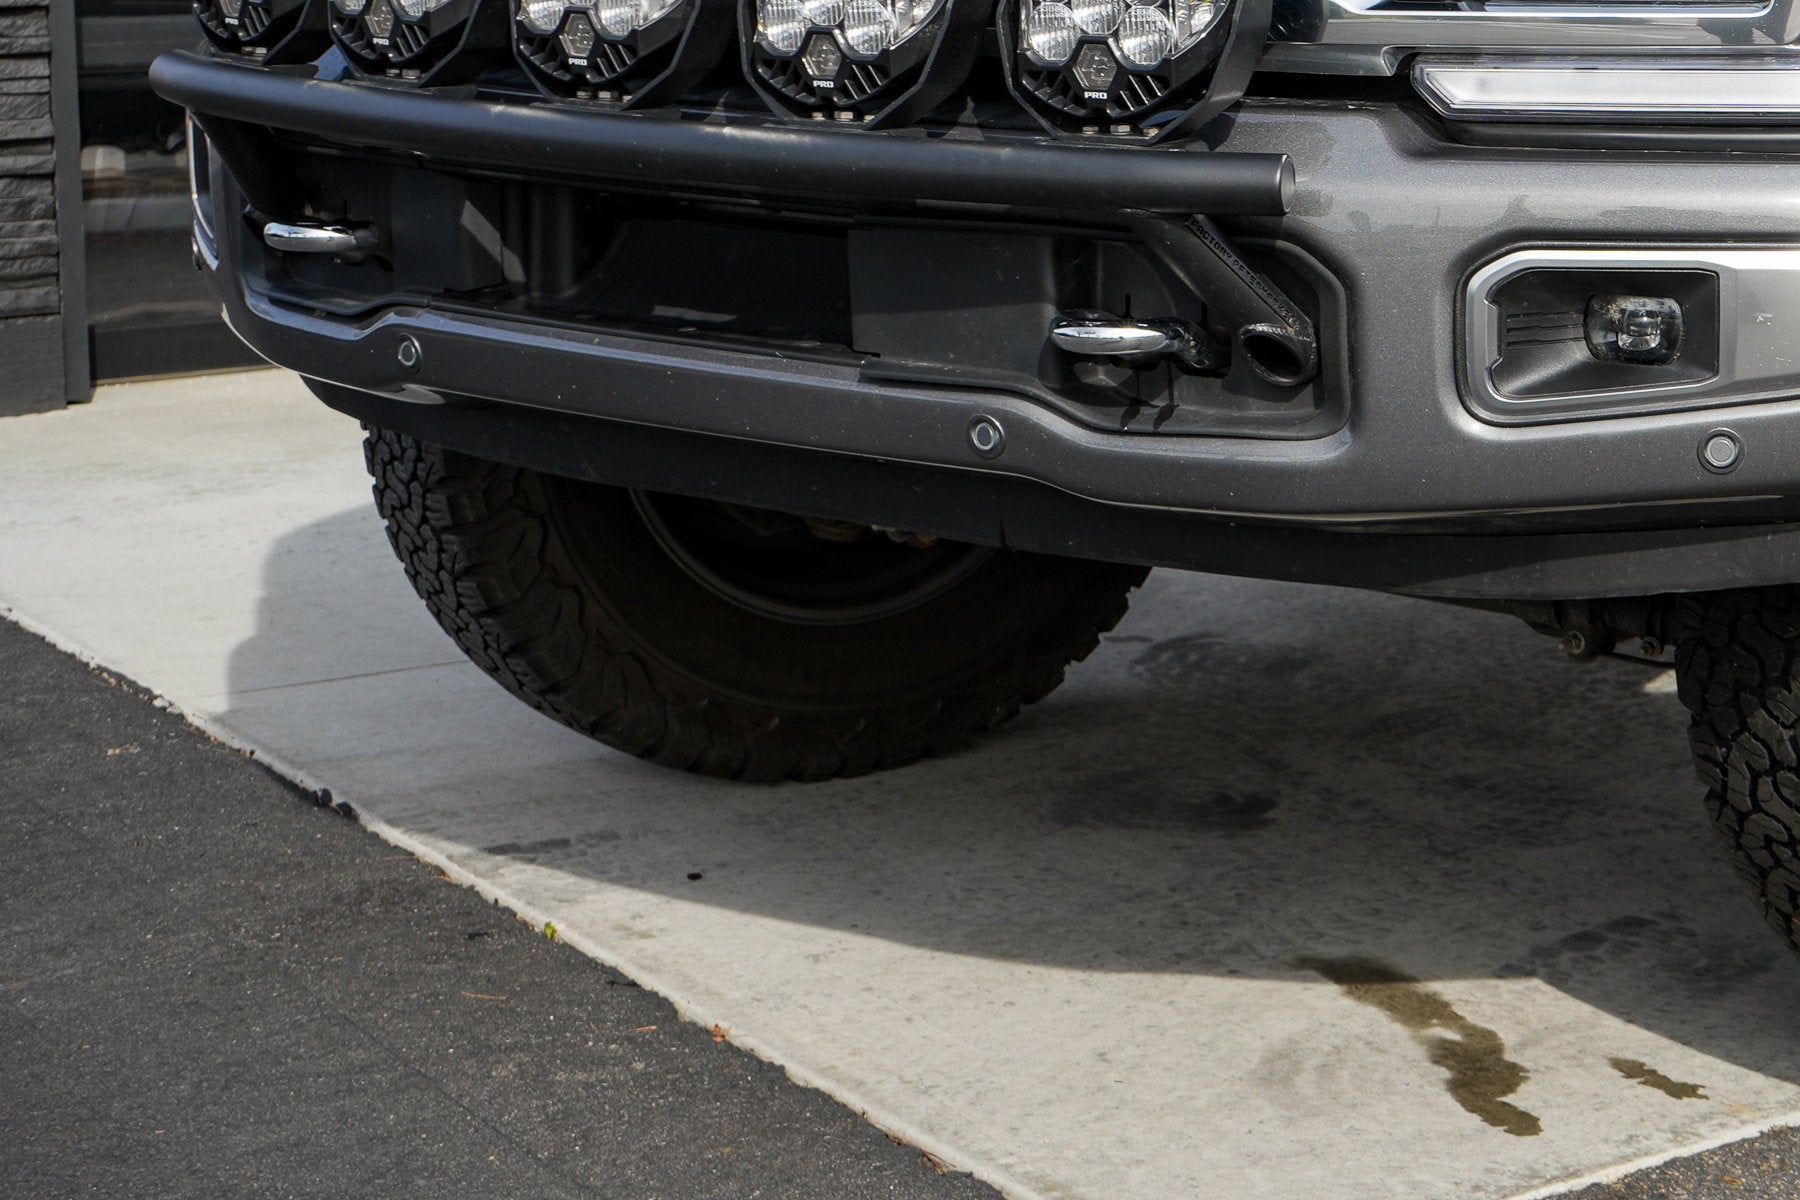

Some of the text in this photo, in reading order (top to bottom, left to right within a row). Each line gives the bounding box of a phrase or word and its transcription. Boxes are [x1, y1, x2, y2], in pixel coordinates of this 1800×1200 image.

[224, 17, 239, 26] PRO
[372, 37, 389, 46] PRO
[568, 57, 588, 66] PRO
[812, 80, 834, 88] PRO
[1083, 91, 1108, 100] PRO
[1190, 219, 1233, 259] FACTORY
